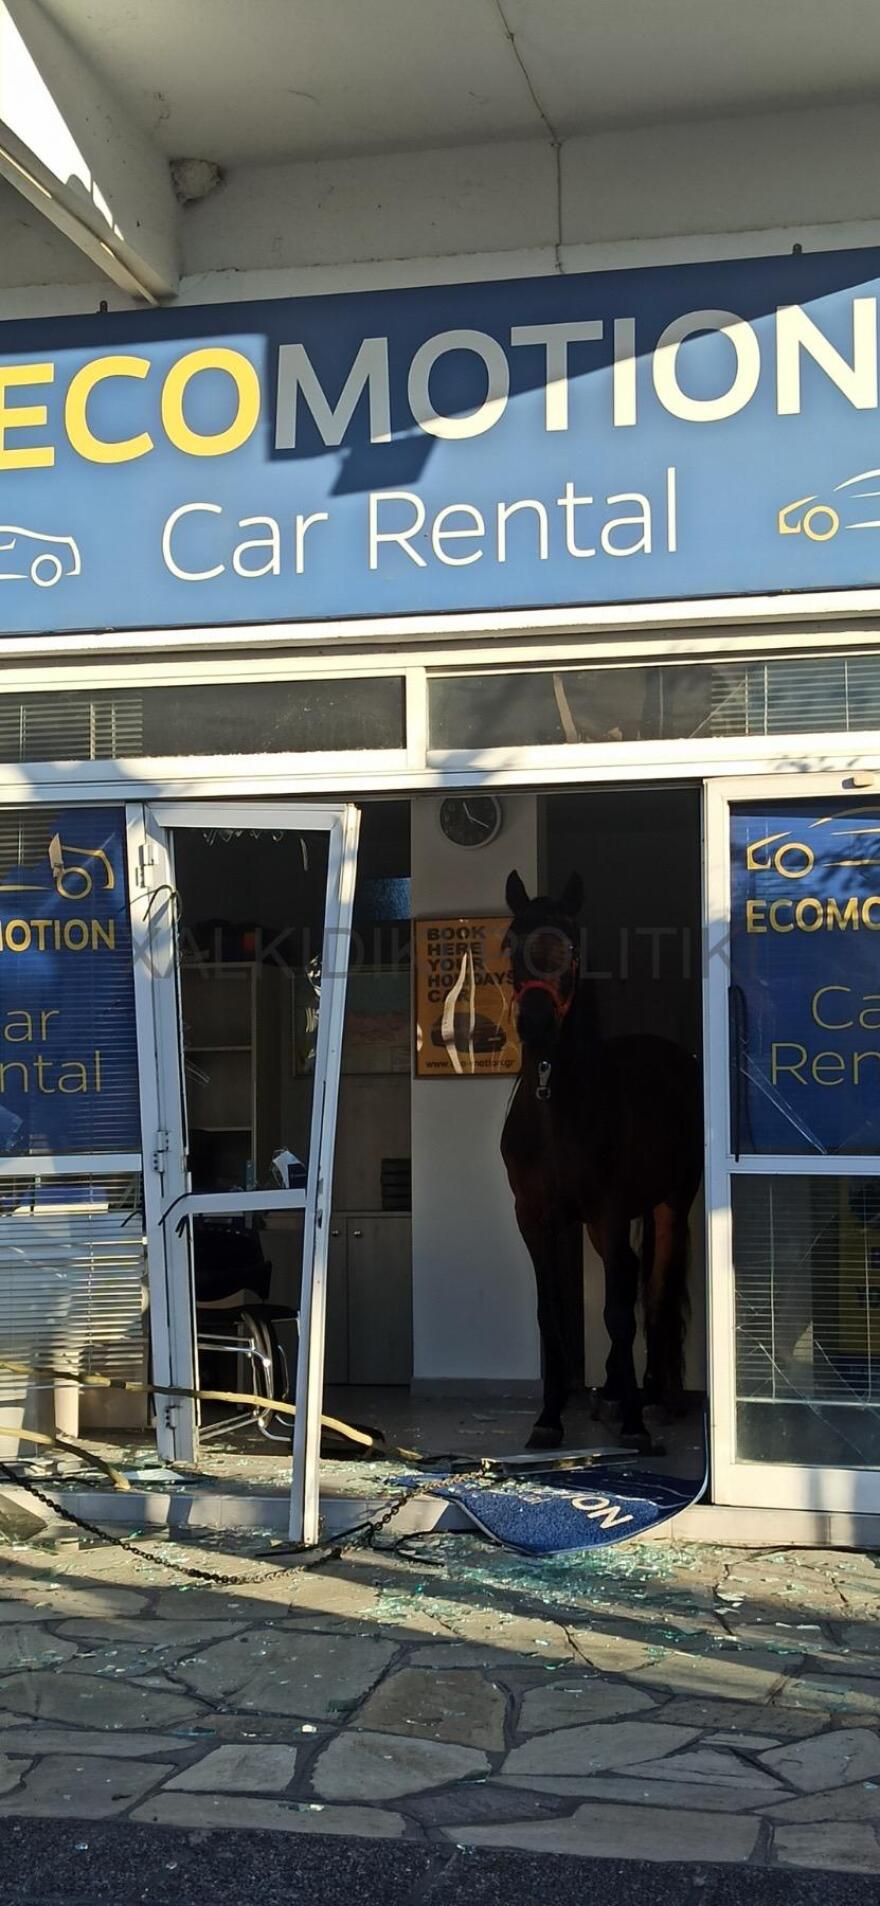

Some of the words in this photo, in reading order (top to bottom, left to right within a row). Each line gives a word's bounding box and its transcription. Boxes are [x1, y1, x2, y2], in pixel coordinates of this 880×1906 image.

[0, 297, 878, 470] ECOMOTION
[161, 503, 328, 582] Car
[369, 467, 678, 571] Rental
[0, 918, 116, 952] OTION
[427, 926, 486, 941] BOOK
[427, 942, 483, 956] HERE
